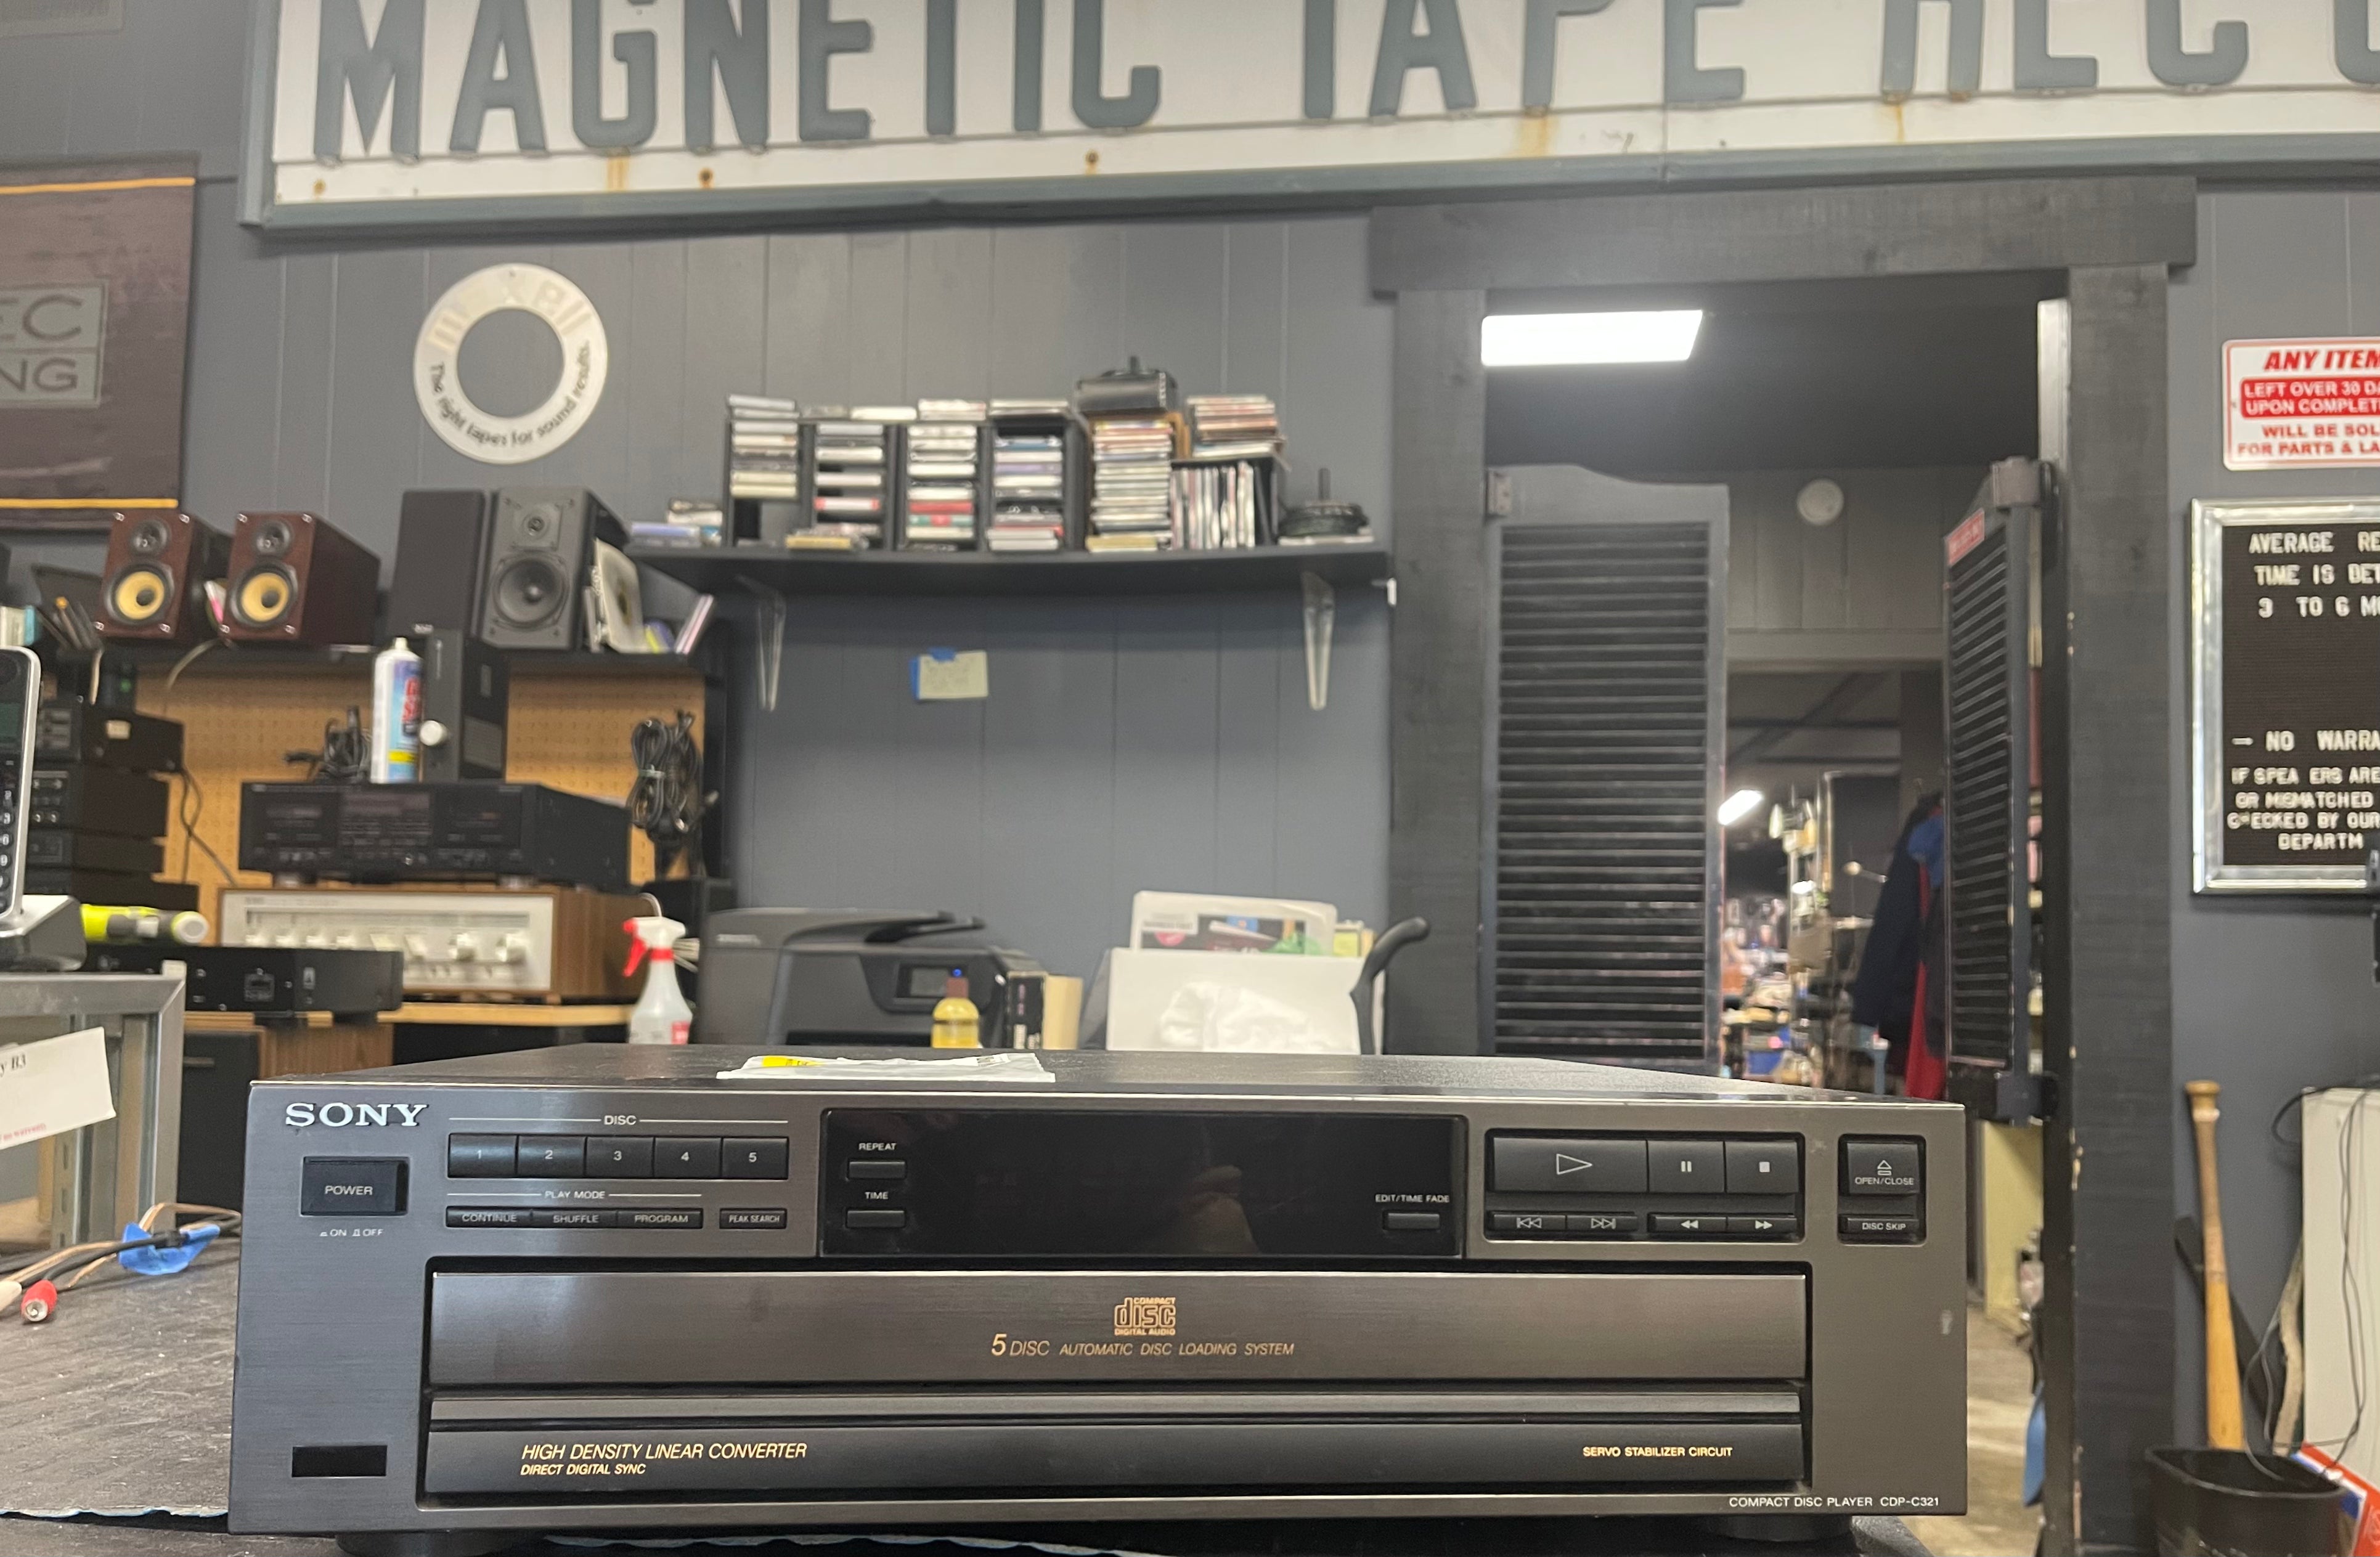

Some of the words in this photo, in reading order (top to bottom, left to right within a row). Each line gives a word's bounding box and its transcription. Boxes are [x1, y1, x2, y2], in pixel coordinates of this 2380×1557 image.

[2263, 350, 2318, 370] ANY
[2323, 349, 2380, 370] ITEM
[2244, 382, 2286, 398] LEFT
[2289, 381, 2338, 397] OVER
[2341, 380, 2361, 396] 30
[2364, 380, 2380, 396] D
[2246, 399, 2294, 415] UPON
[2298, 397, 2380, 413] COMPLET
[2262, 425, 2307, 438] WILL
[2314, 423, 2337, 437] BE
[511, 429, 534, 447] for
[2238, 442, 2272, 455] FOR
[2279, 442, 2334, 455] PARTS
[2249, 531, 2335, 554] AVERAGE
[2253, 564, 2301, 586] TIME
[2312, 563, 2335, 585] IS
[2258, 597, 2274, 618] 3
[2295, 596, 2324, 617] TO
[2334, 595, 2351, 617] 6
[2265, 730, 2295, 752] NO
[2316, 730, 2380, 751] WARRA
[2231, 767, 2250, 785] IF
[2348, 766, 2380, 784] ARE
[2235, 791, 2260, 808] OR
[2264, 791, 2374, 809] MISMATCHED
[2317, 811, 2340, 829] BY
[2346, 811, 2380, 829] OUR
[285, 1102, 427, 1127] SONY
[604, 1115, 637, 1126] DISC
[858, 1142, 897, 1151] REPEAT
[476, 1150, 483, 1159] 1
[545, 1150, 554, 1160] 2
[613, 1150, 622, 1161] 3
[681, 1152, 690, 1161] 4
[749, 1152, 757, 1163] 5
[1854, 1177, 1914, 1185] OPEN/CLOSE
[325, 1185, 373, 1195] POWER
[544, 1190, 571, 1199] PLAY
[574, 1190, 605, 1199] MODE
[865, 1192, 889, 1200] TIME
[1375, 1194, 1423, 1203] EDIT/TIME
[1425, 1195, 1449, 1203] FADE
[462, 1213, 518, 1222] CONTINUE
[553, 1214, 599, 1224] SHUFFLE
[634, 1214, 688, 1224] PROGRAM
[728, 1214, 749, 1223] PEAK
[750, 1215, 780, 1223] SEARCH
[1862, 1222, 1883, 1230] DISC
[1886, 1222, 1906, 1230] SKIP
[329, 1229, 347, 1237] ON
[362, 1229, 383, 1237] OFF
[1114, 1328, 1147, 1336] DIGITAL
[1147, 1328, 1176, 1336] AUDIO
[991, 1333, 1007, 1356] 5
[1009, 1340, 1050, 1356] DISC
[1059, 1343, 1133, 1356] AUTOMATIC
[1140, 1343, 1173, 1356] DISC
[1178, 1343, 1237, 1356] LOADING
[1244, 1343, 1295, 1356] SYSTEM
[521, 1444, 566, 1460] HIGH
[569, 1443, 643, 1460] DENSITY
[645, 1443, 704, 1459] LINEAR
[708, 1442, 807, 1459] CONVERTER
[1583, 1446, 1621, 1457] SERVO
[1624, 1447, 1685, 1457] STABILIZER
[1689, 1447, 1733, 1457] CIRCUIT
[520, 1464, 564, 1476] DIRECT
[566, 1463, 611, 1475] DIGITAL
[614, 1463, 646, 1475] SYNC
[1729, 1497, 1790, 1507] COMPACT
[1794, 1497, 1823, 1507] DISC
[1827, 1497, 1873, 1507] PLAYER
[1880, 1497, 1939, 1506] CDP-C321
